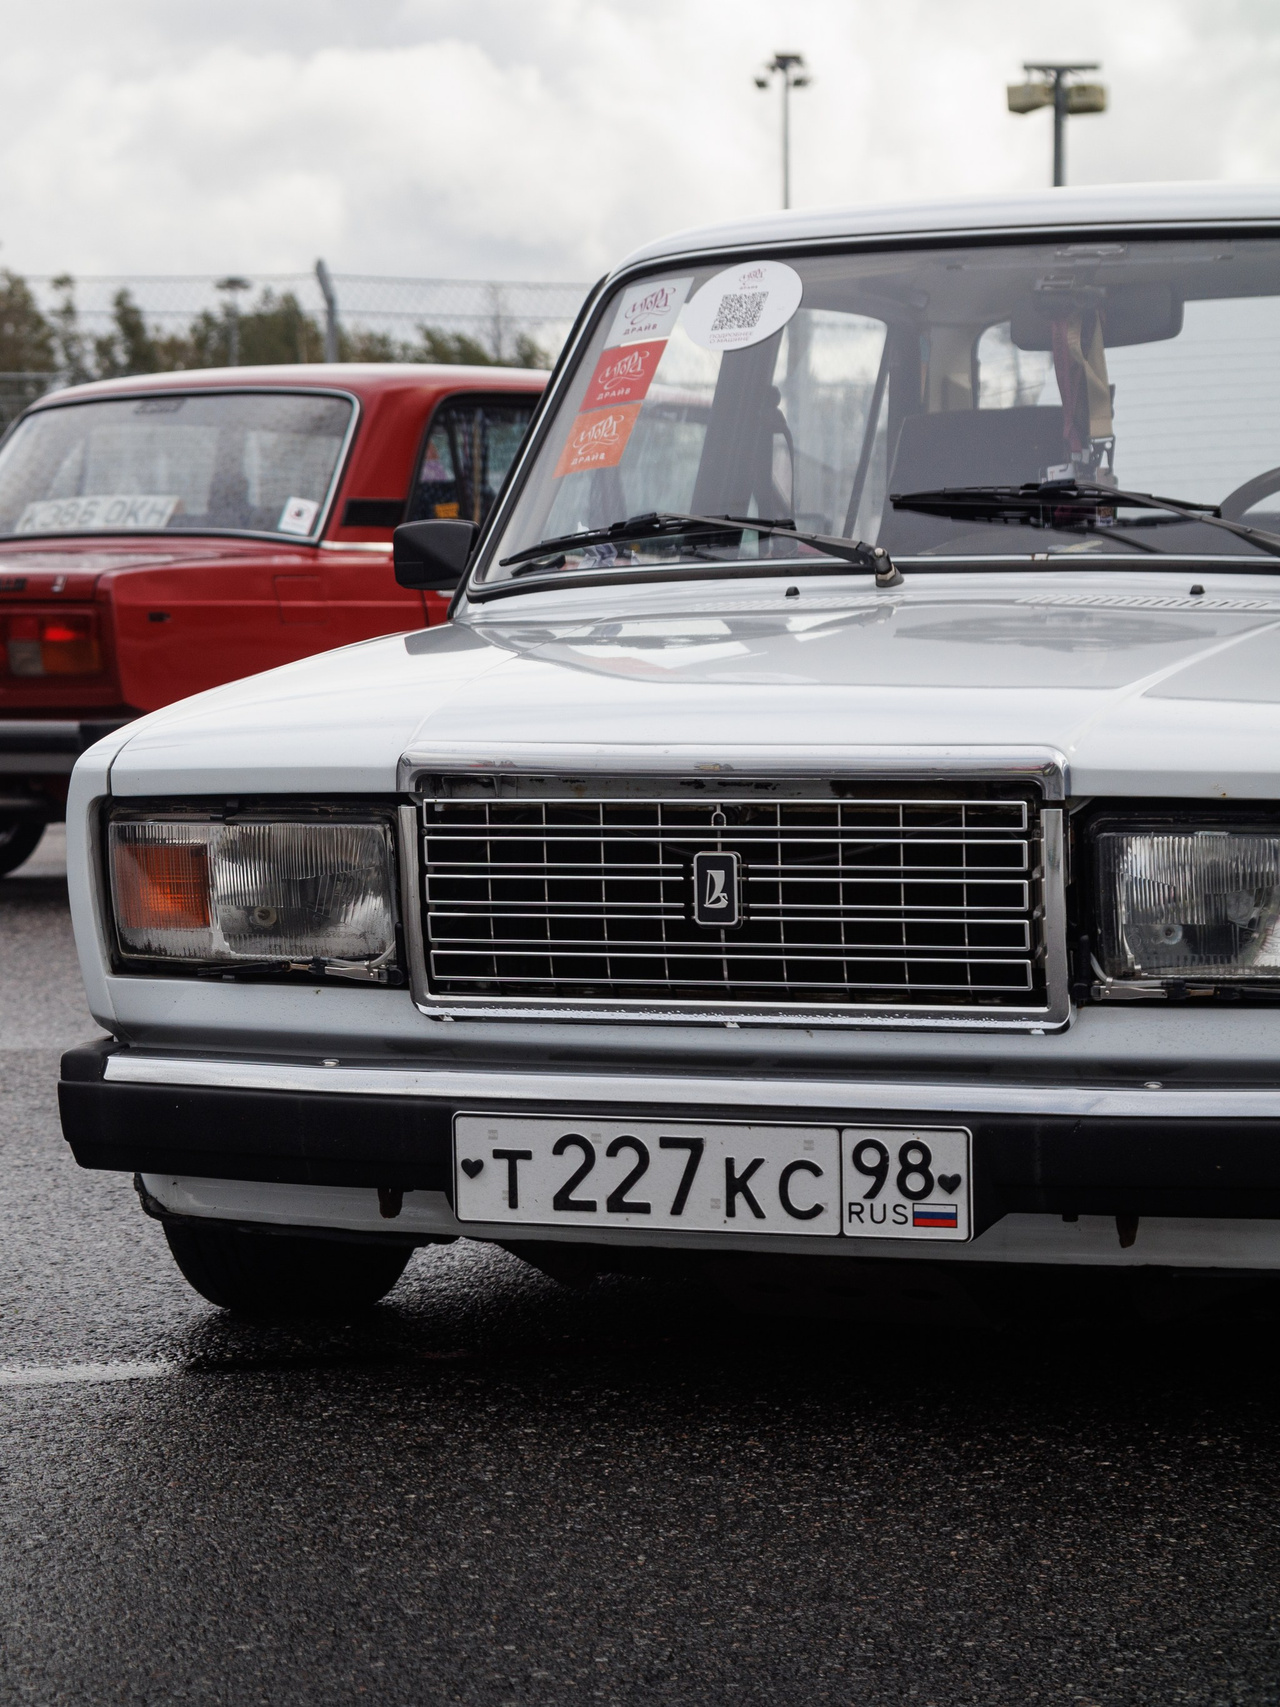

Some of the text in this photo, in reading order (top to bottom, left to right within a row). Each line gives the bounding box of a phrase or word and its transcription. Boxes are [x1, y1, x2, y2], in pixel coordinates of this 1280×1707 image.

[623, 322, 658, 336] ДРАЙВ
[596, 387, 631, 400] ДРАЙВ
[571, 452, 606, 466] ДРАЙВ
[852, 1138, 935, 1201] 98
[847, 1202, 909, 1225] RUS
